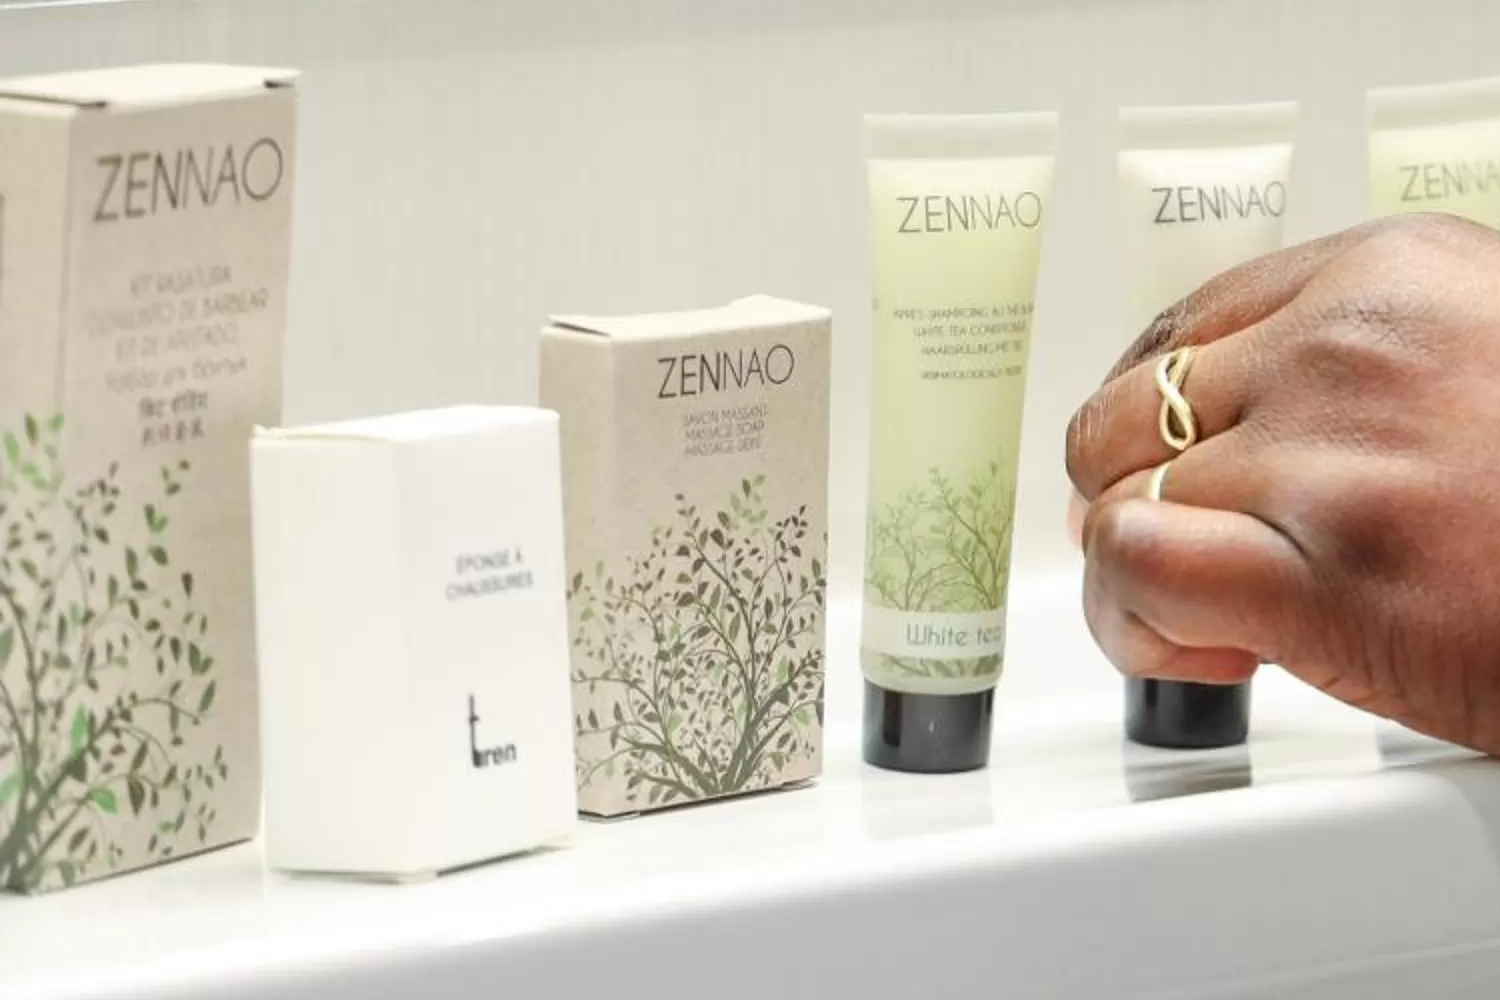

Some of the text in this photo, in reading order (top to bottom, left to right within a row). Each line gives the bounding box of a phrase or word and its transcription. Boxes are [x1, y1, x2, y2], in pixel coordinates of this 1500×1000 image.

[93, 137, 284, 223] ZENNAO
[896, 191, 1042, 233] ZENNAO
[1151, 181, 1286, 223] ZENNAO
[657, 344, 795, 399] ZENNAO
[906, 623, 1004, 646] White tea
